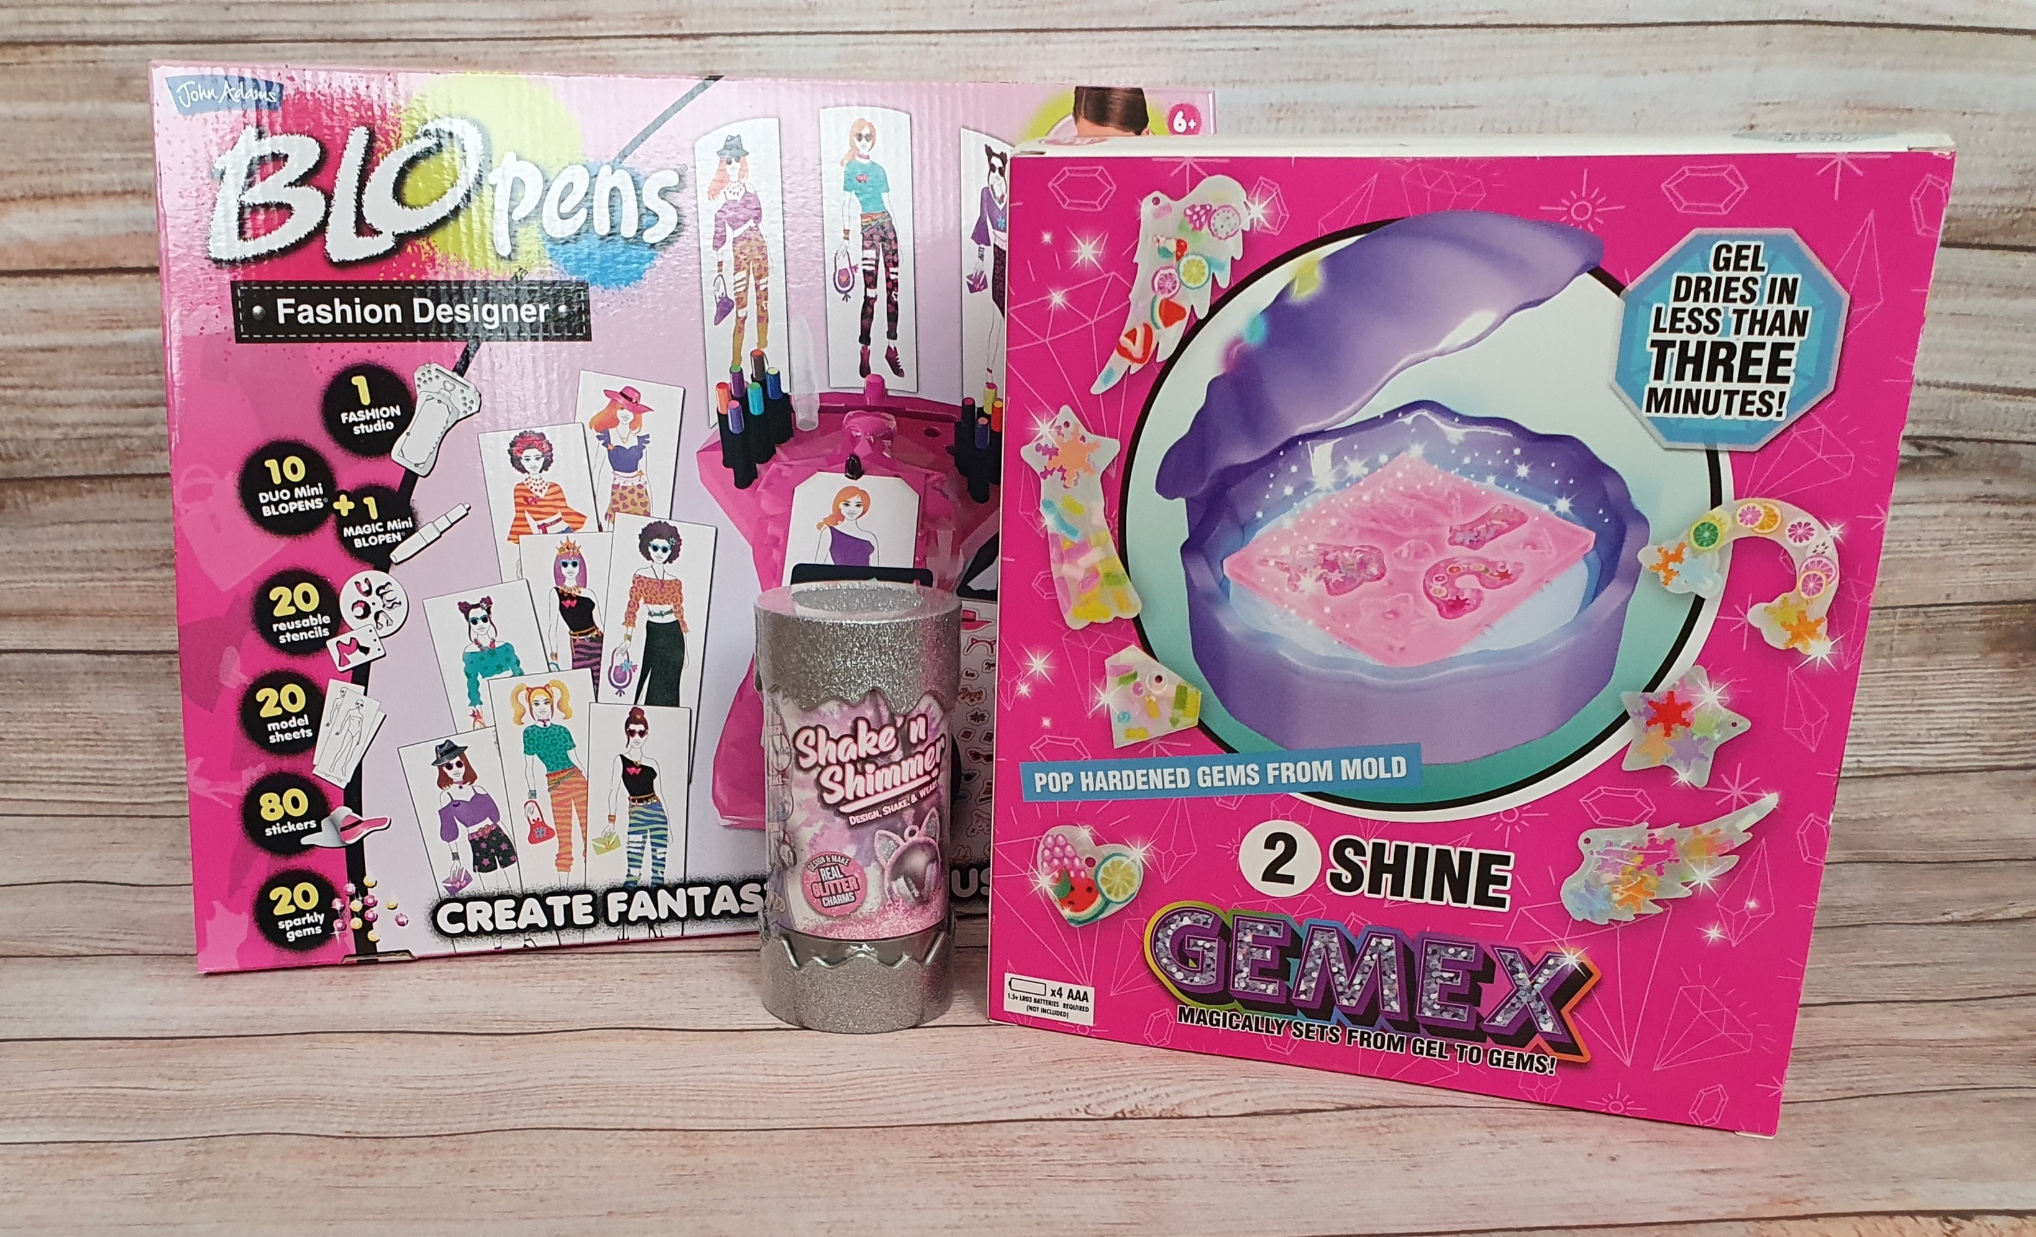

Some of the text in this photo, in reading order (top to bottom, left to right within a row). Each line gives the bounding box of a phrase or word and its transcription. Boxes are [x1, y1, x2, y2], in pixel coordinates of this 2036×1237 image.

[176, 80, 278, 108] John Adams
[1173, 110, 1197, 133] 6+
[1712, 243, 1766, 273] GEL
[1673, 275, 1798, 305] DRIES IN
[276, 298, 552, 329] Fashion Designer
[1652, 306, 1809, 337] LESS THAN
[1649, 339, 1796, 385] THREE
[351, 375, 371, 406] 1
[1645, 387, 1787, 418] MINUTES!
[340, 405, 402, 425] FASHION
[353, 419, 394, 436] studio
[264, 455, 306, 485] 10
[258, 483, 324, 504] DUO Mini
[343, 516, 414, 537] MAGIC Mini
[269, 582, 320, 617] 20
[272, 613, 331, 632] reusable
[278, 626, 330, 645] stencils
[255, 683, 306, 718] 20
[267, 714, 309, 732] model
[268, 727, 313, 744] sheets
[820, 736, 945, 805] Shimmer
[1034, 756, 1407, 793] POP HARDENED GEMS FROM MOLD
[259, 788, 309, 821] 80
[264, 819, 317, 837] stickers
[831, 854, 850, 866] MAKE
[1260, 831, 1514, 910] 2 SHINE
[819, 865, 844, 881] REAL
[269, 882, 319, 916] 20
[812, 876, 859, 898] GLITTER
[821, 891, 855, 907] CHARMS
[277, 911, 325, 931] sparkly
[436, 893, 594, 934] CREATE
[607, 883, 767, 924] FANTAS
[285, 924, 322, 942] gems
[1146, 902, 1596, 1057] GEMEX
[1034, 998, 1059, 1007] BATTERIES
[1062, 1002, 1089, 1012] REQUIRED
[1050, 987, 1089, 1003] x4 AAA
[1026, 1005, 1069, 1019] (NOT INCLUDED)
[1177, 1006, 1556, 1076] MAGICALLY SETS FROM GEL TO GEMS!
